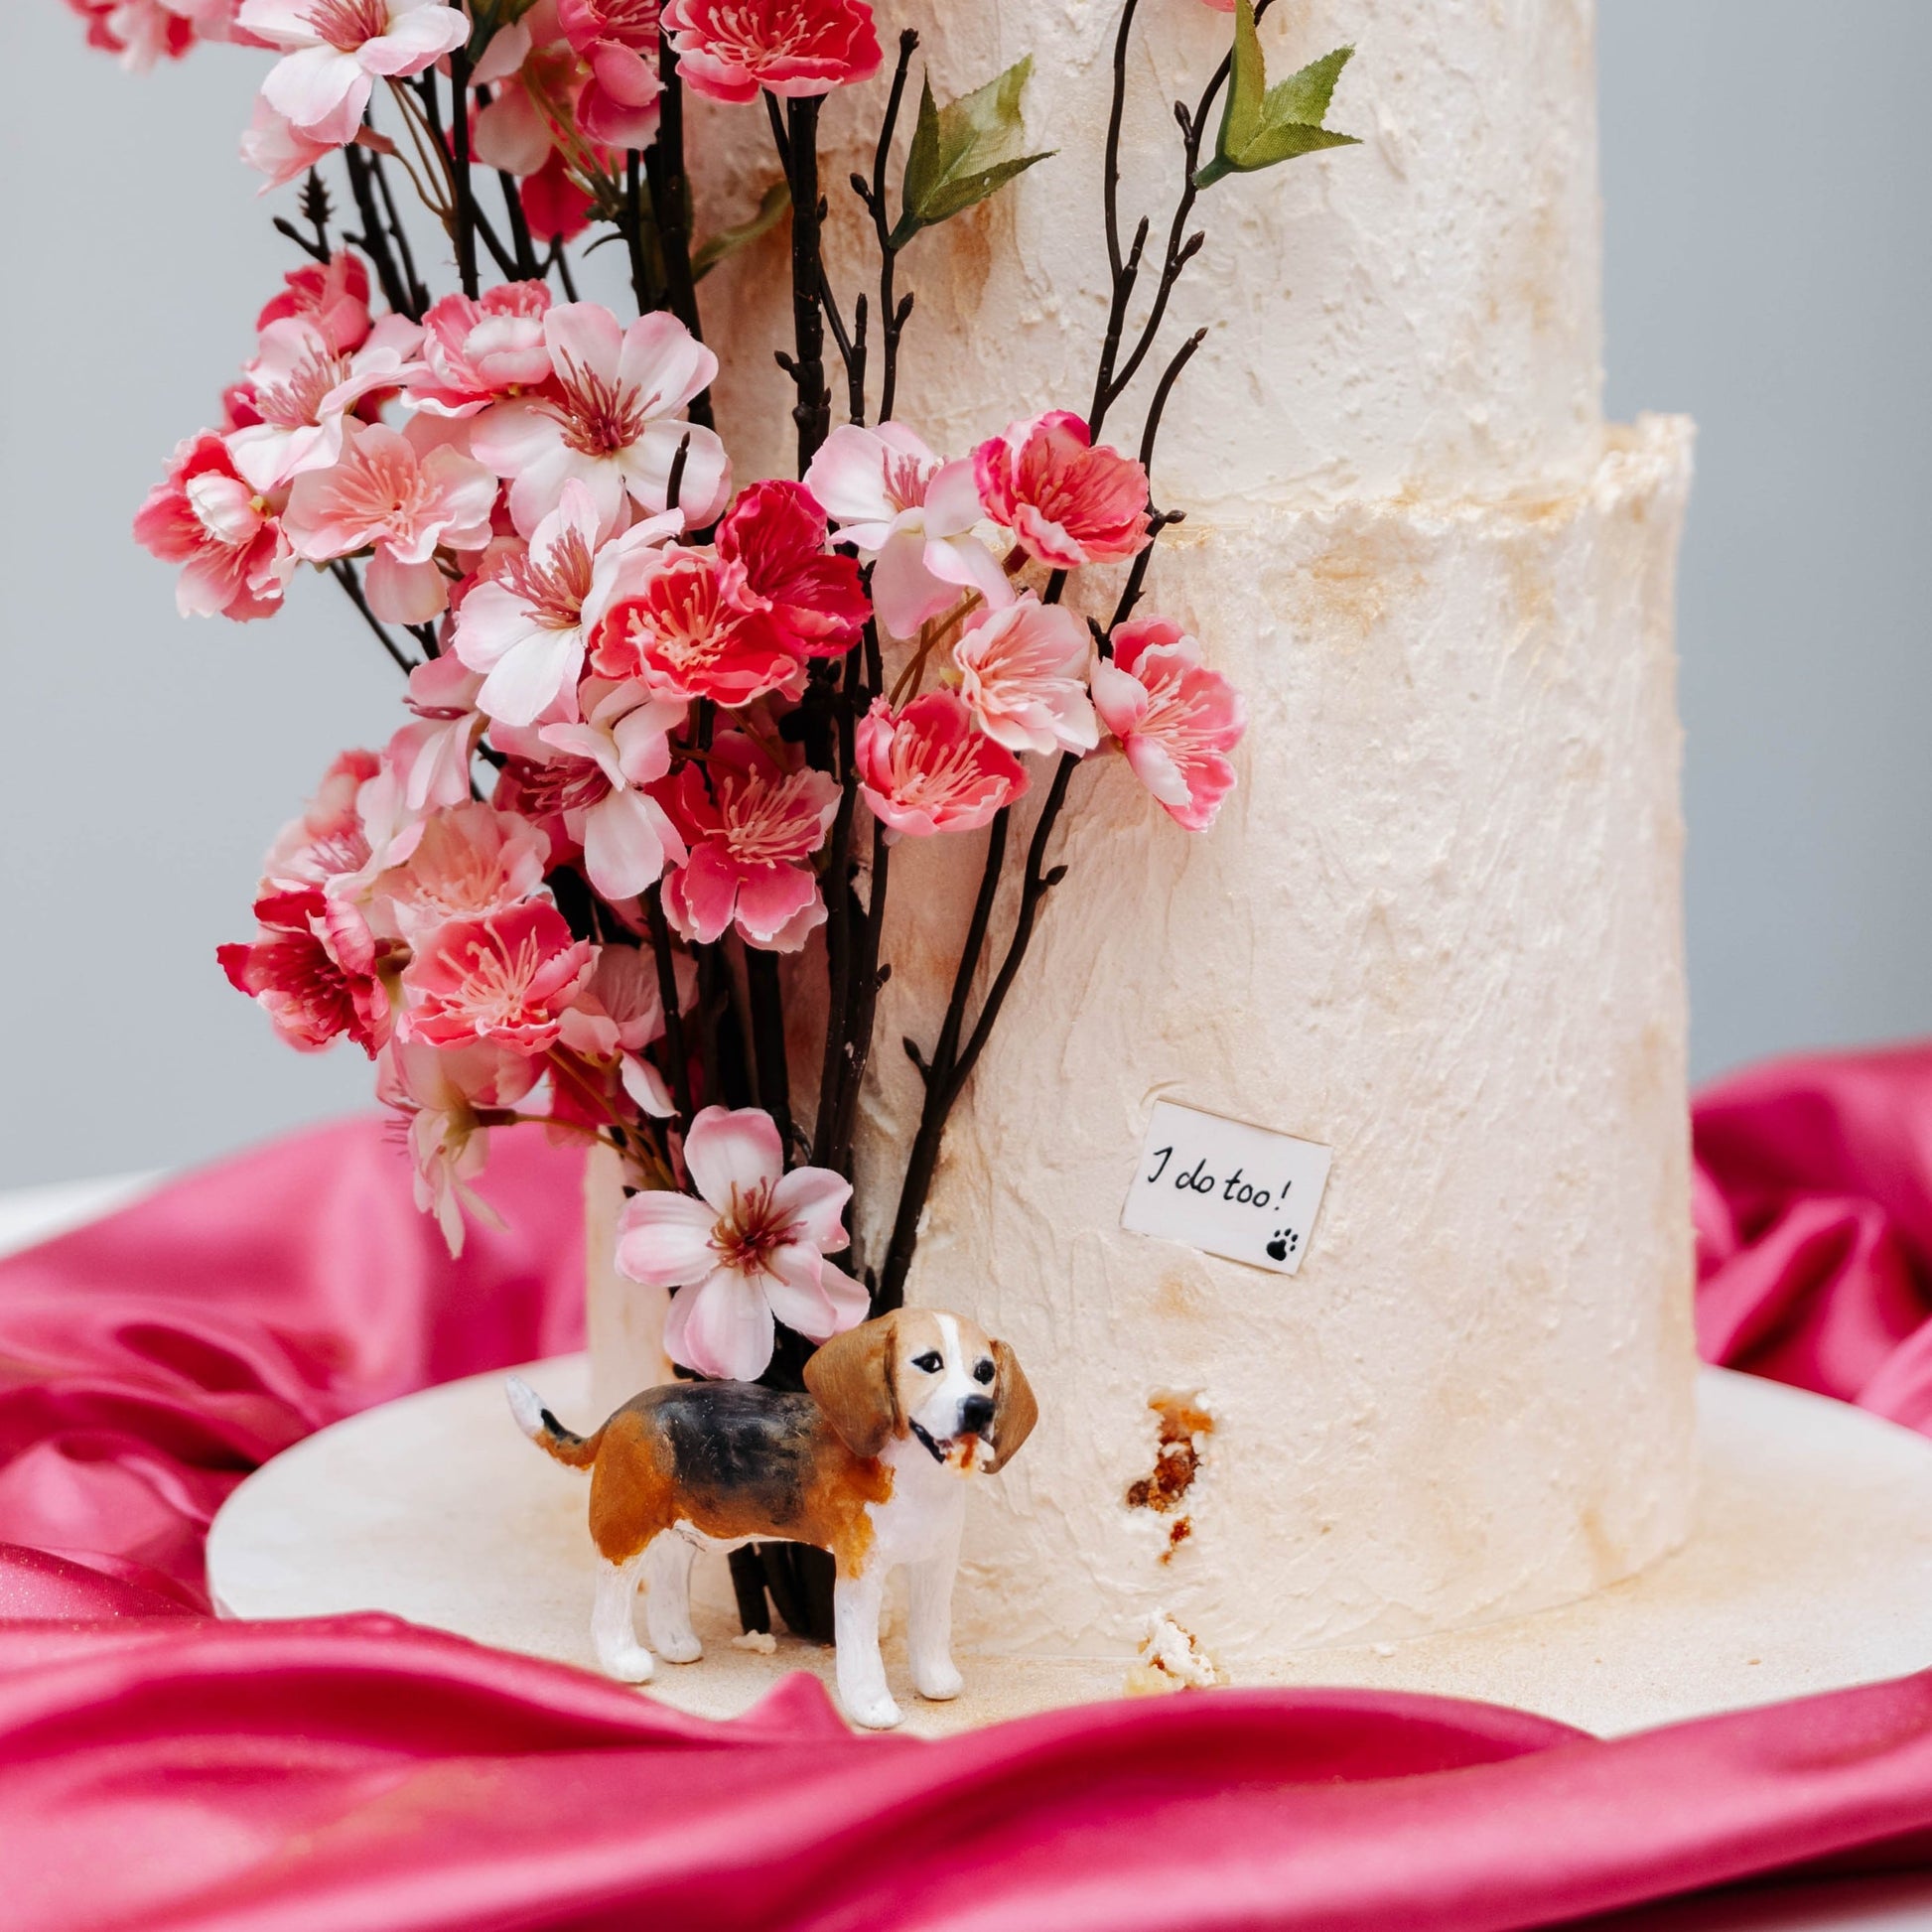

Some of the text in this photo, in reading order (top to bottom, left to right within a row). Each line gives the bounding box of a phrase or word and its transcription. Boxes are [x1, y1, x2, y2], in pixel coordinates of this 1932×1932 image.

[1147, 1146, 1292, 1211] I do too!
